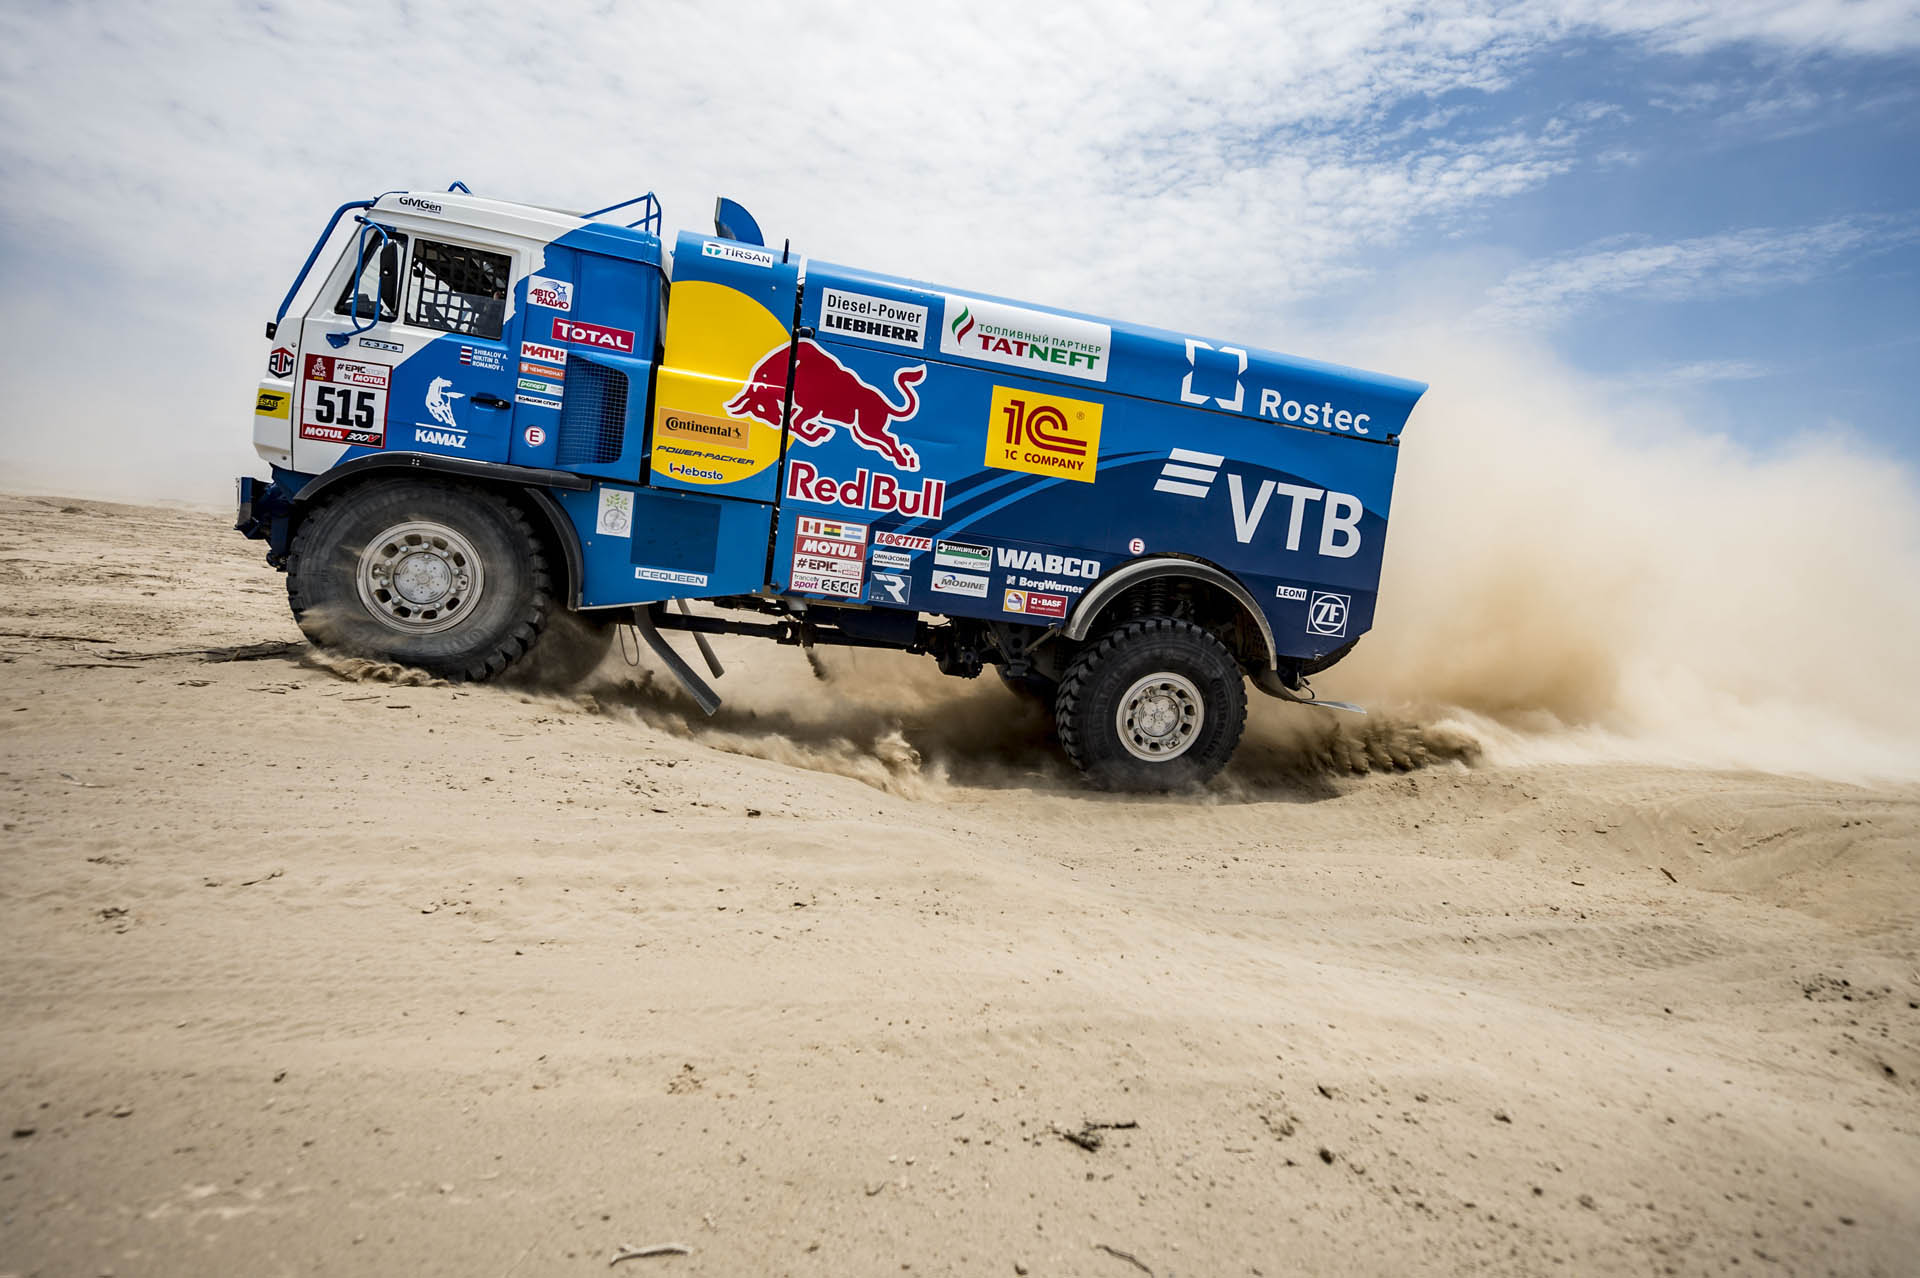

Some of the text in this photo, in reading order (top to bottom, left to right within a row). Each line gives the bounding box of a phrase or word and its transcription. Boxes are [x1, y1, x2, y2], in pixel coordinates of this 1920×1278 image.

[399, 196, 442, 212] GMGen
[530, 288, 557, 299] АВТО
[536, 297, 569, 310] РАДИО
[827, 295, 922, 324] Diesel-Power
[558, 322, 630, 349] TOTAL
[825, 315, 918, 342] LIEBHERR
[978, 324, 1102, 355] ТОПЛИВНЫЙ ПАРТНЕР
[522, 343, 564, 362] МАТЧ!
[977, 334, 1100, 370] TATNEFT
[354, 374, 384, 385] MOTUL
[258, 399, 278, 408] ESAB
[316, 386, 375, 428] 515
[1259, 388, 1371, 435] Rostec
[304, 428, 380, 442] MOTUL 300V
[529, 430, 538, 443] E
[665, 418, 732, 438] Continental
[416, 429, 467, 449] KAMAZ
[656, 445, 755, 466] POWER-PACKER
[1024, 453, 1084, 471] COMPANY
[790, 462, 944, 519] Red Bull
[1227, 473, 1363, 560] VTB
[801, 539, 858, 558] MOTUL
[877, 533, 930, 550] LOCTITE
[1132, 539, 1141, 552] E
[996, 547, 1101, 580] WABCO
[638, 569, 705, 585] ICEQUEEN
[941, 579, 986, 591] MODINE
[1019, 576, 1084, 594] BorgWarner
[794, 579, 859, 594] sport 2340
[1278, 588, 1306, 600] LEONI
[1041, 599, 1062, 608] BASF
[1315, 602, 1343, 626] ZF
